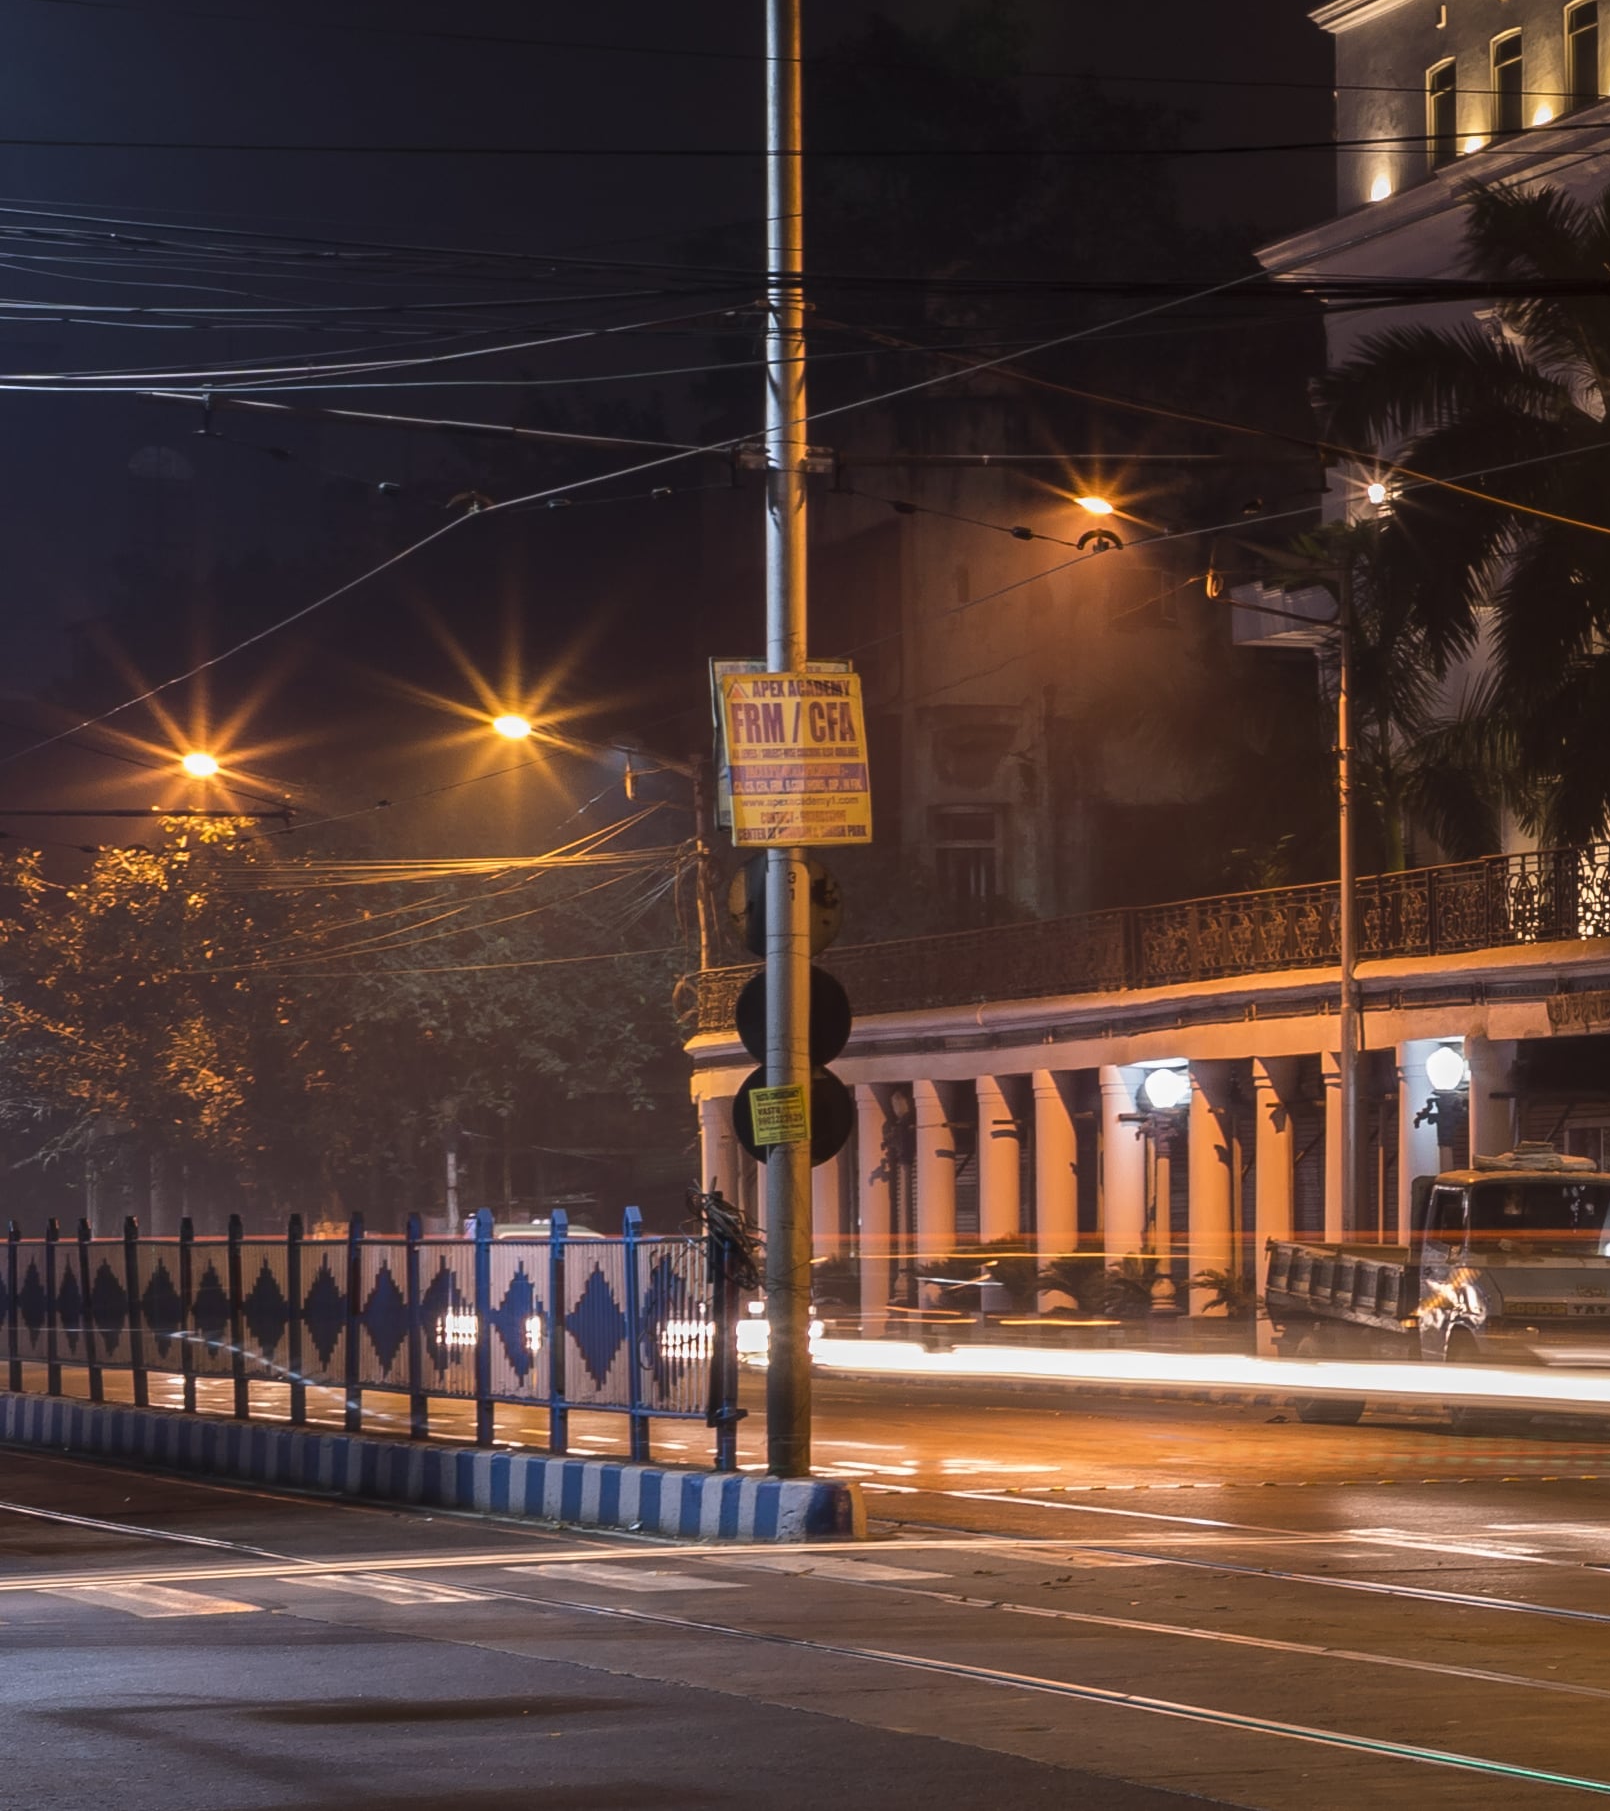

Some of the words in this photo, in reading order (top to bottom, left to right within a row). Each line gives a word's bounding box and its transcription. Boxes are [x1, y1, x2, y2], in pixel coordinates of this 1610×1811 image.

[752, 679, 786, 699] APEX
[788, 678, 851, 698] ACADEMY
[730, 702, 786, 745] FRM
[808, 701, 857, 743] CFA
